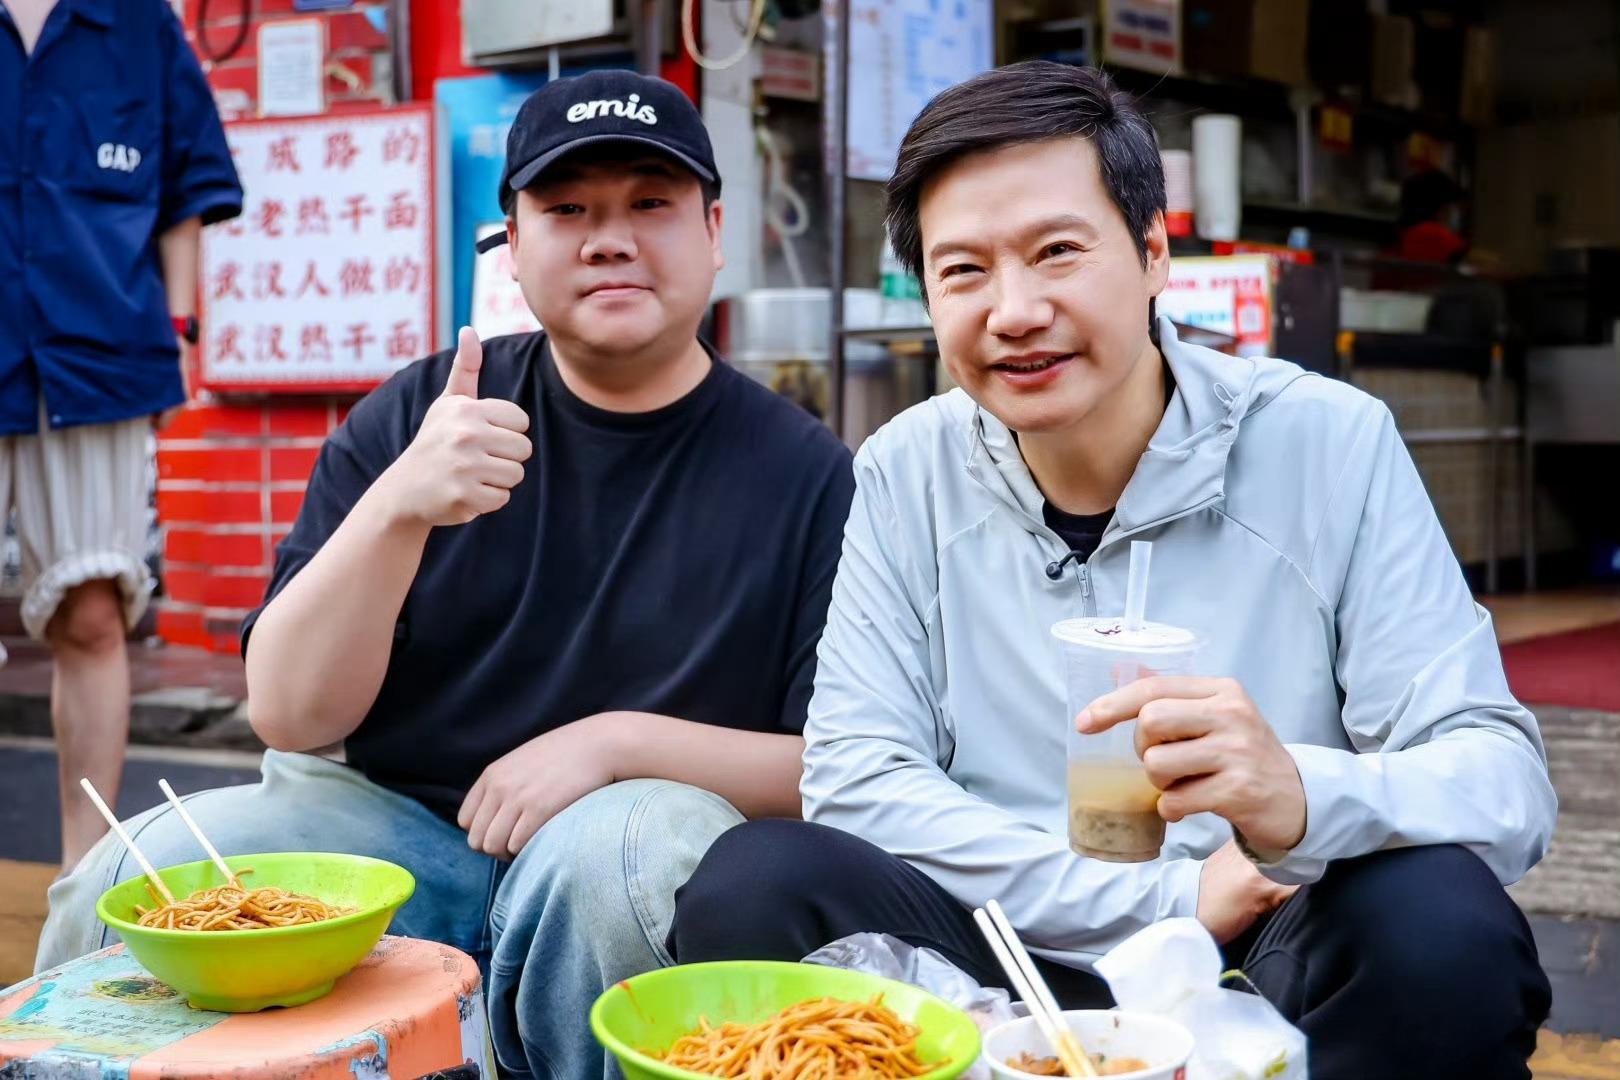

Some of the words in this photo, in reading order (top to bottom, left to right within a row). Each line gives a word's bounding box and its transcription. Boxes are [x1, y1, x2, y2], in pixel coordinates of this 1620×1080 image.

[567, 93, 657, 125] emis
[97, 142, 141, 173] GAP
[213, 256, 422, 300] 武汉人做的
[213, 319, 420, 364] 武汉热干面
